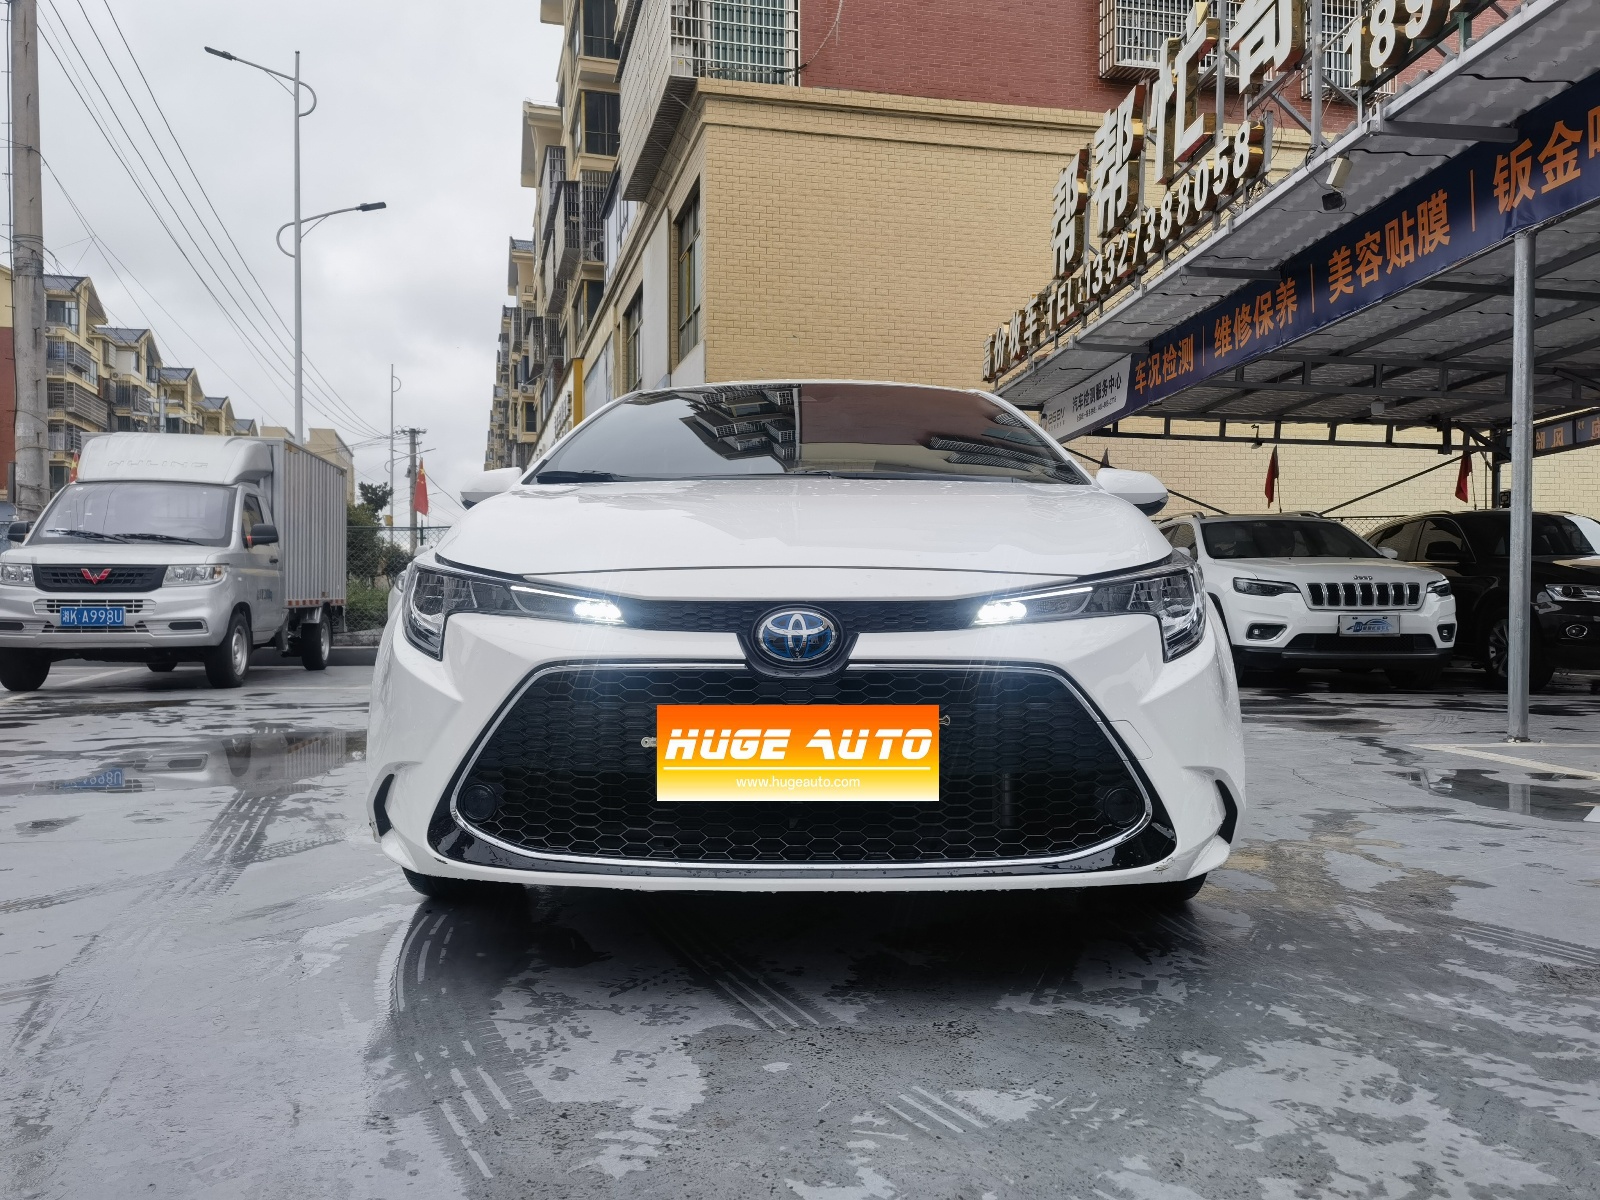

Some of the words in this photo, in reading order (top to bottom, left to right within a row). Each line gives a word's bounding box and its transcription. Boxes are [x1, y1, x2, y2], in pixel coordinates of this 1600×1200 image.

[1343, 0, 1460, 87] 189
[1135, 334, 1194, 394] 车况检测
[1214, 277, 1298, 358] 维修保养
[1328, 189, 1450, 303] 美容贴膜
